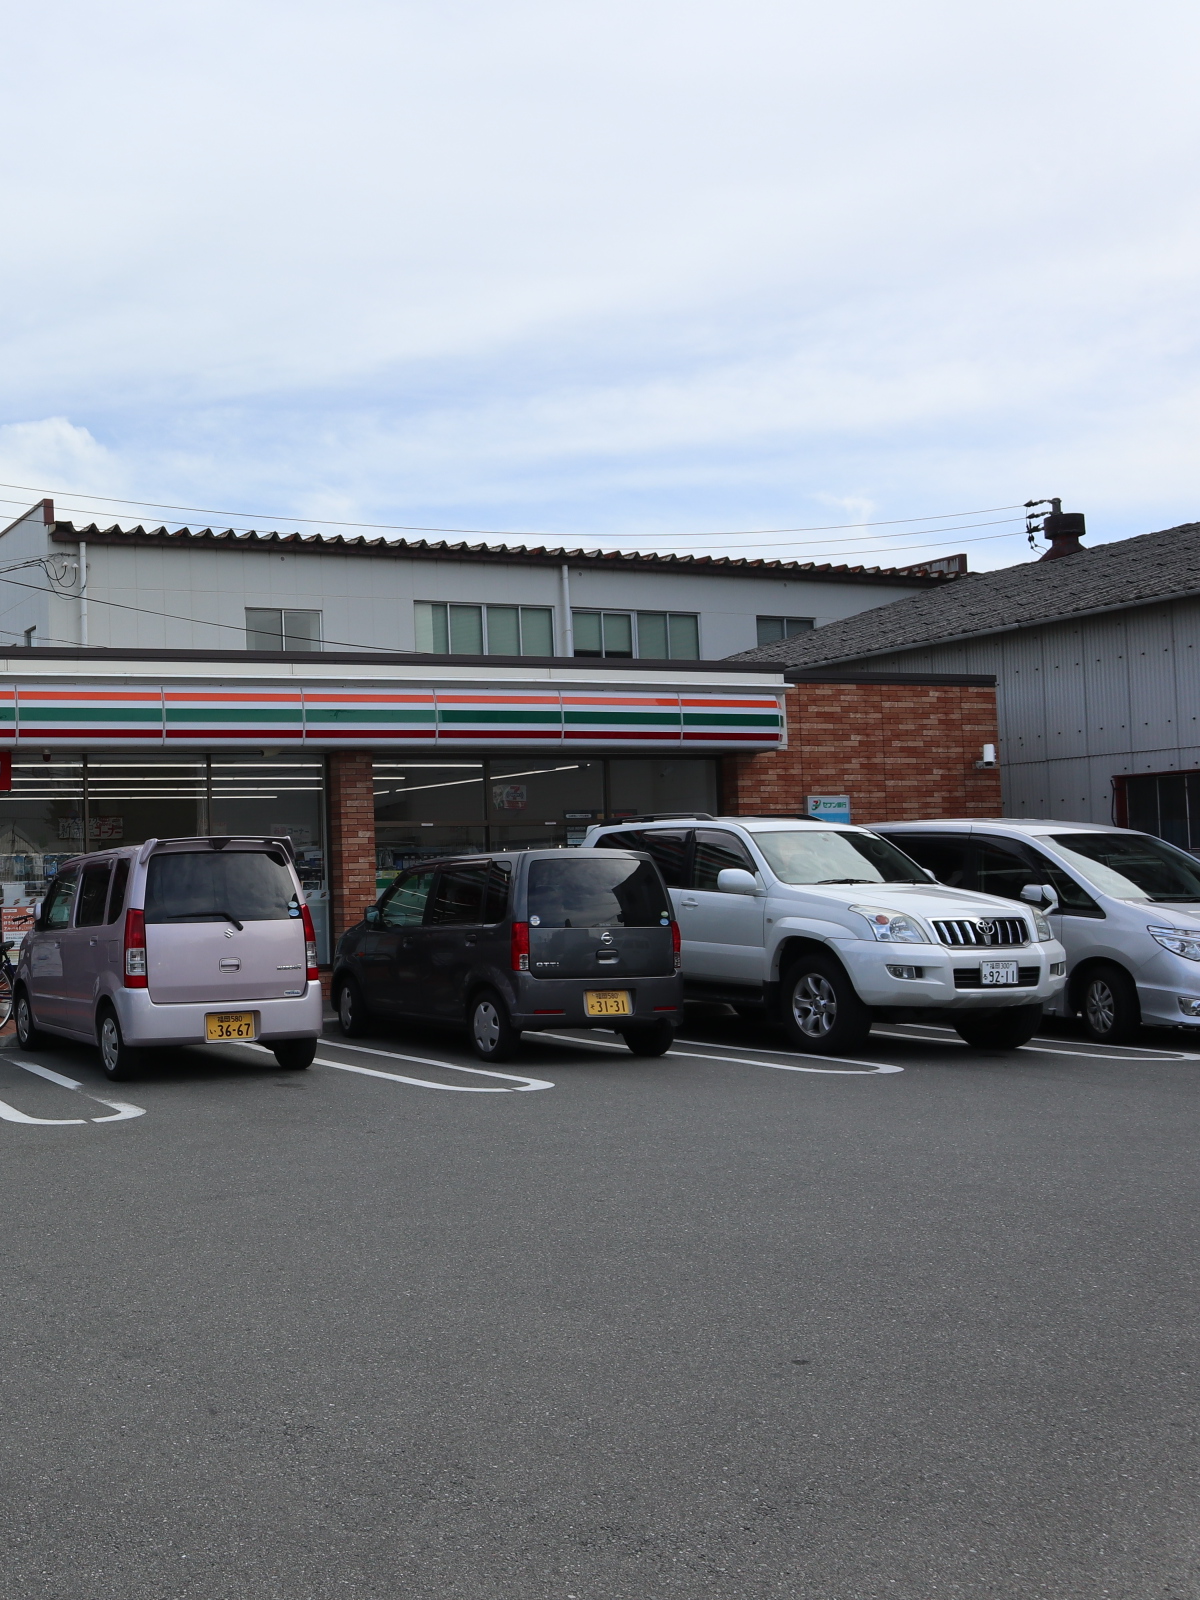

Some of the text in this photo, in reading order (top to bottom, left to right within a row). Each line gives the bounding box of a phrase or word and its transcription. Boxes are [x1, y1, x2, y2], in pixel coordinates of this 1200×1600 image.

[989, 970, 1015, 983] 92-11
[596, 1000, 626, 1013] 31-31
[217, 1023, 251, 1037] 36-67
